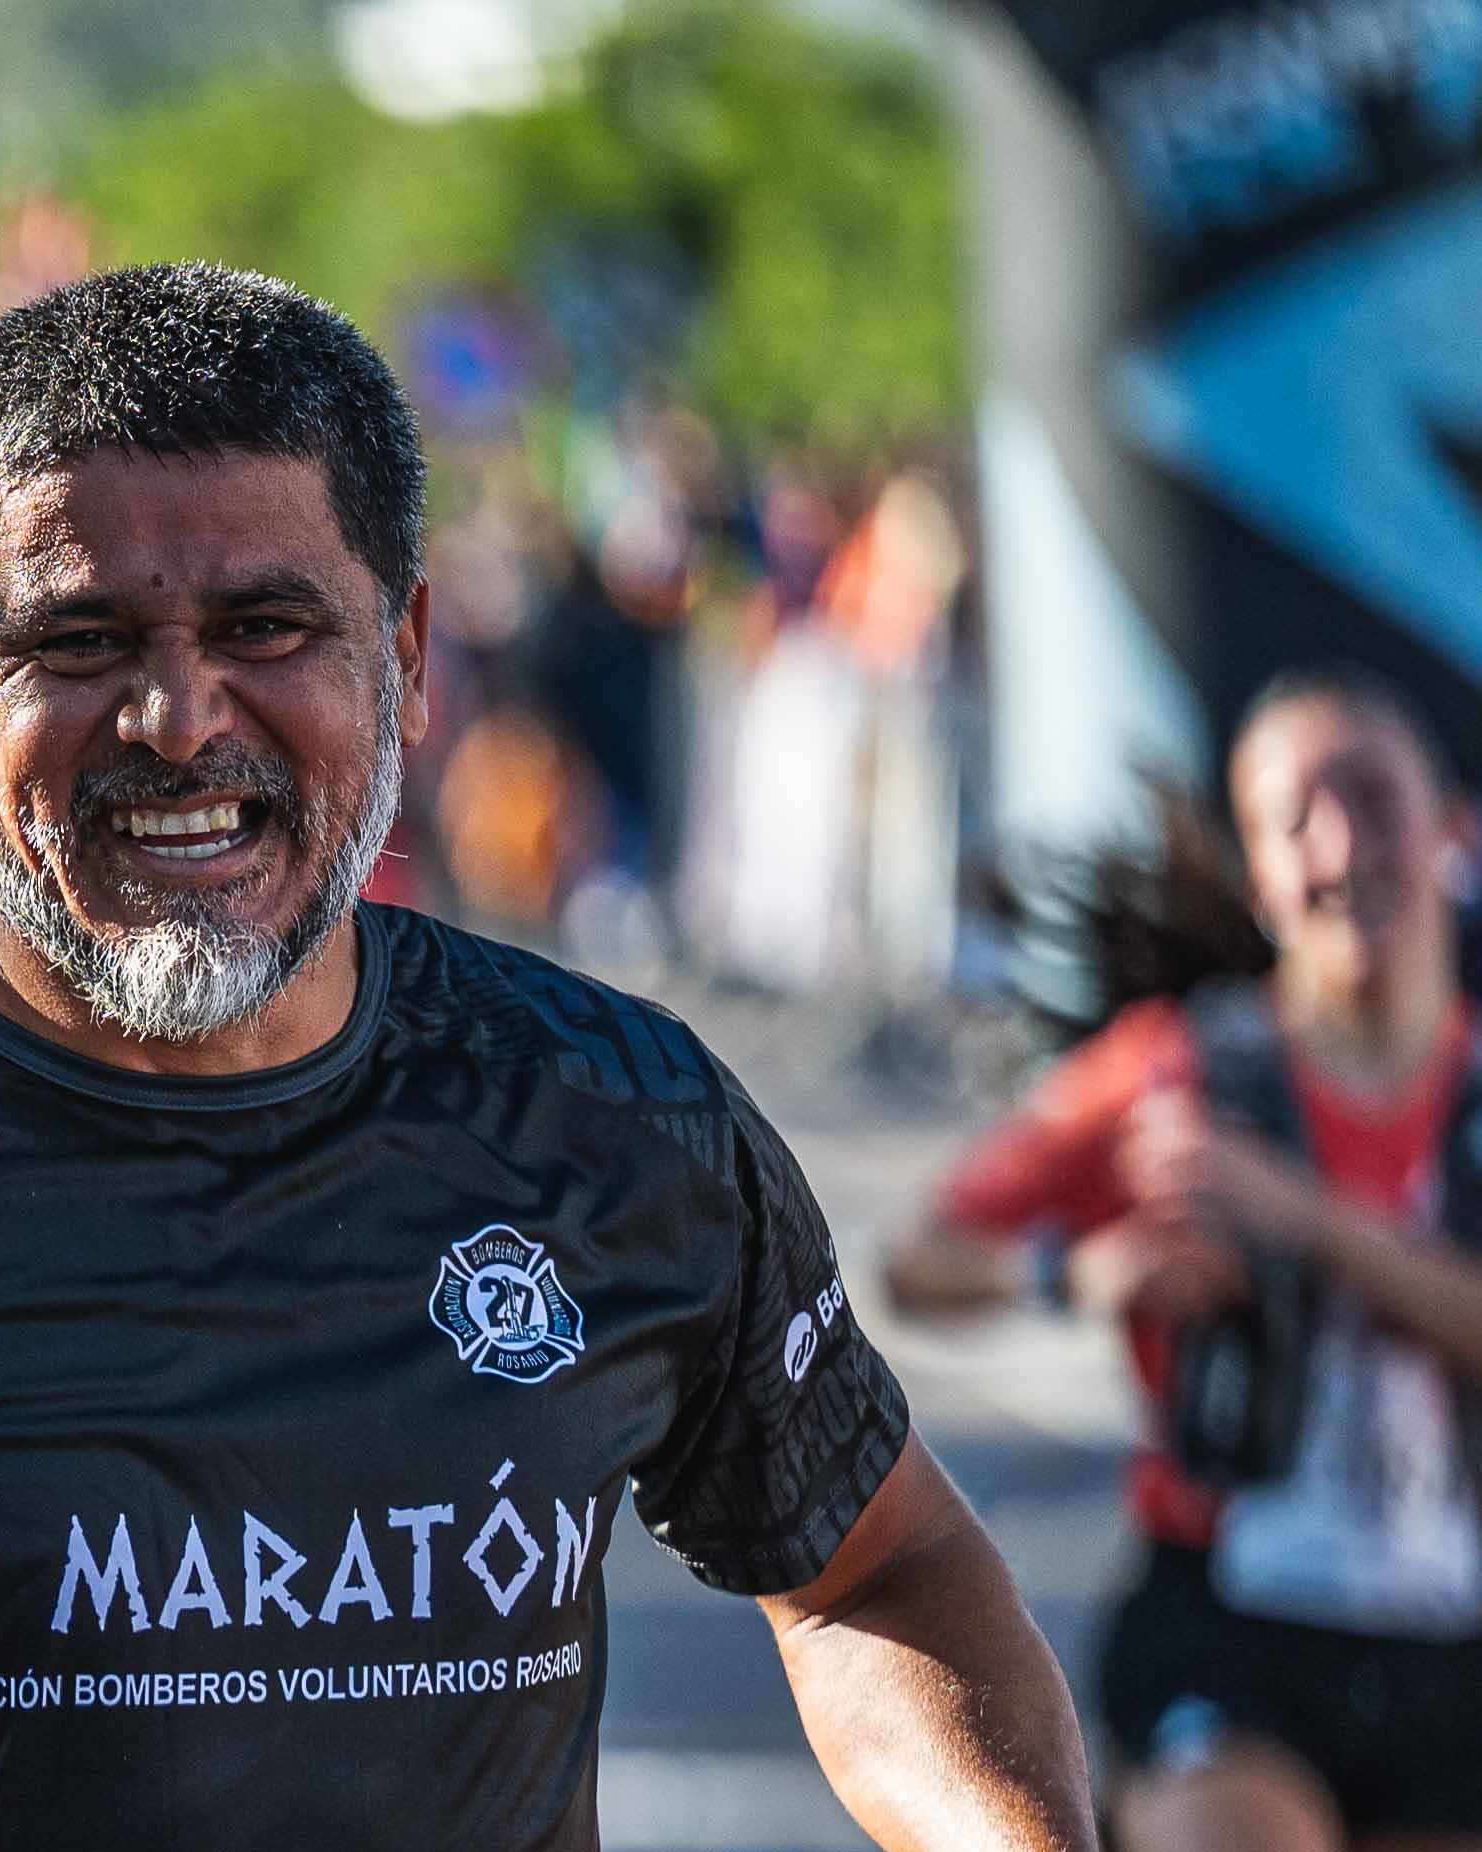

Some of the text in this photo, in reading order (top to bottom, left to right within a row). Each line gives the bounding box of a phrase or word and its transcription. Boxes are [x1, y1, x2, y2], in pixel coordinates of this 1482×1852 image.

[471, 1241, 526, 1265] BOMBEROS
[497, 1350, 550, 1369] ROSARIO
[50, 1457, 598, 1635] MARATÓN
[74, 1668, 268, 1707] BOMBEROS
[277, 1657, 508, 1703] VOLUNTARIOS
[515, 1639, 582, 1690] ROSARIO
